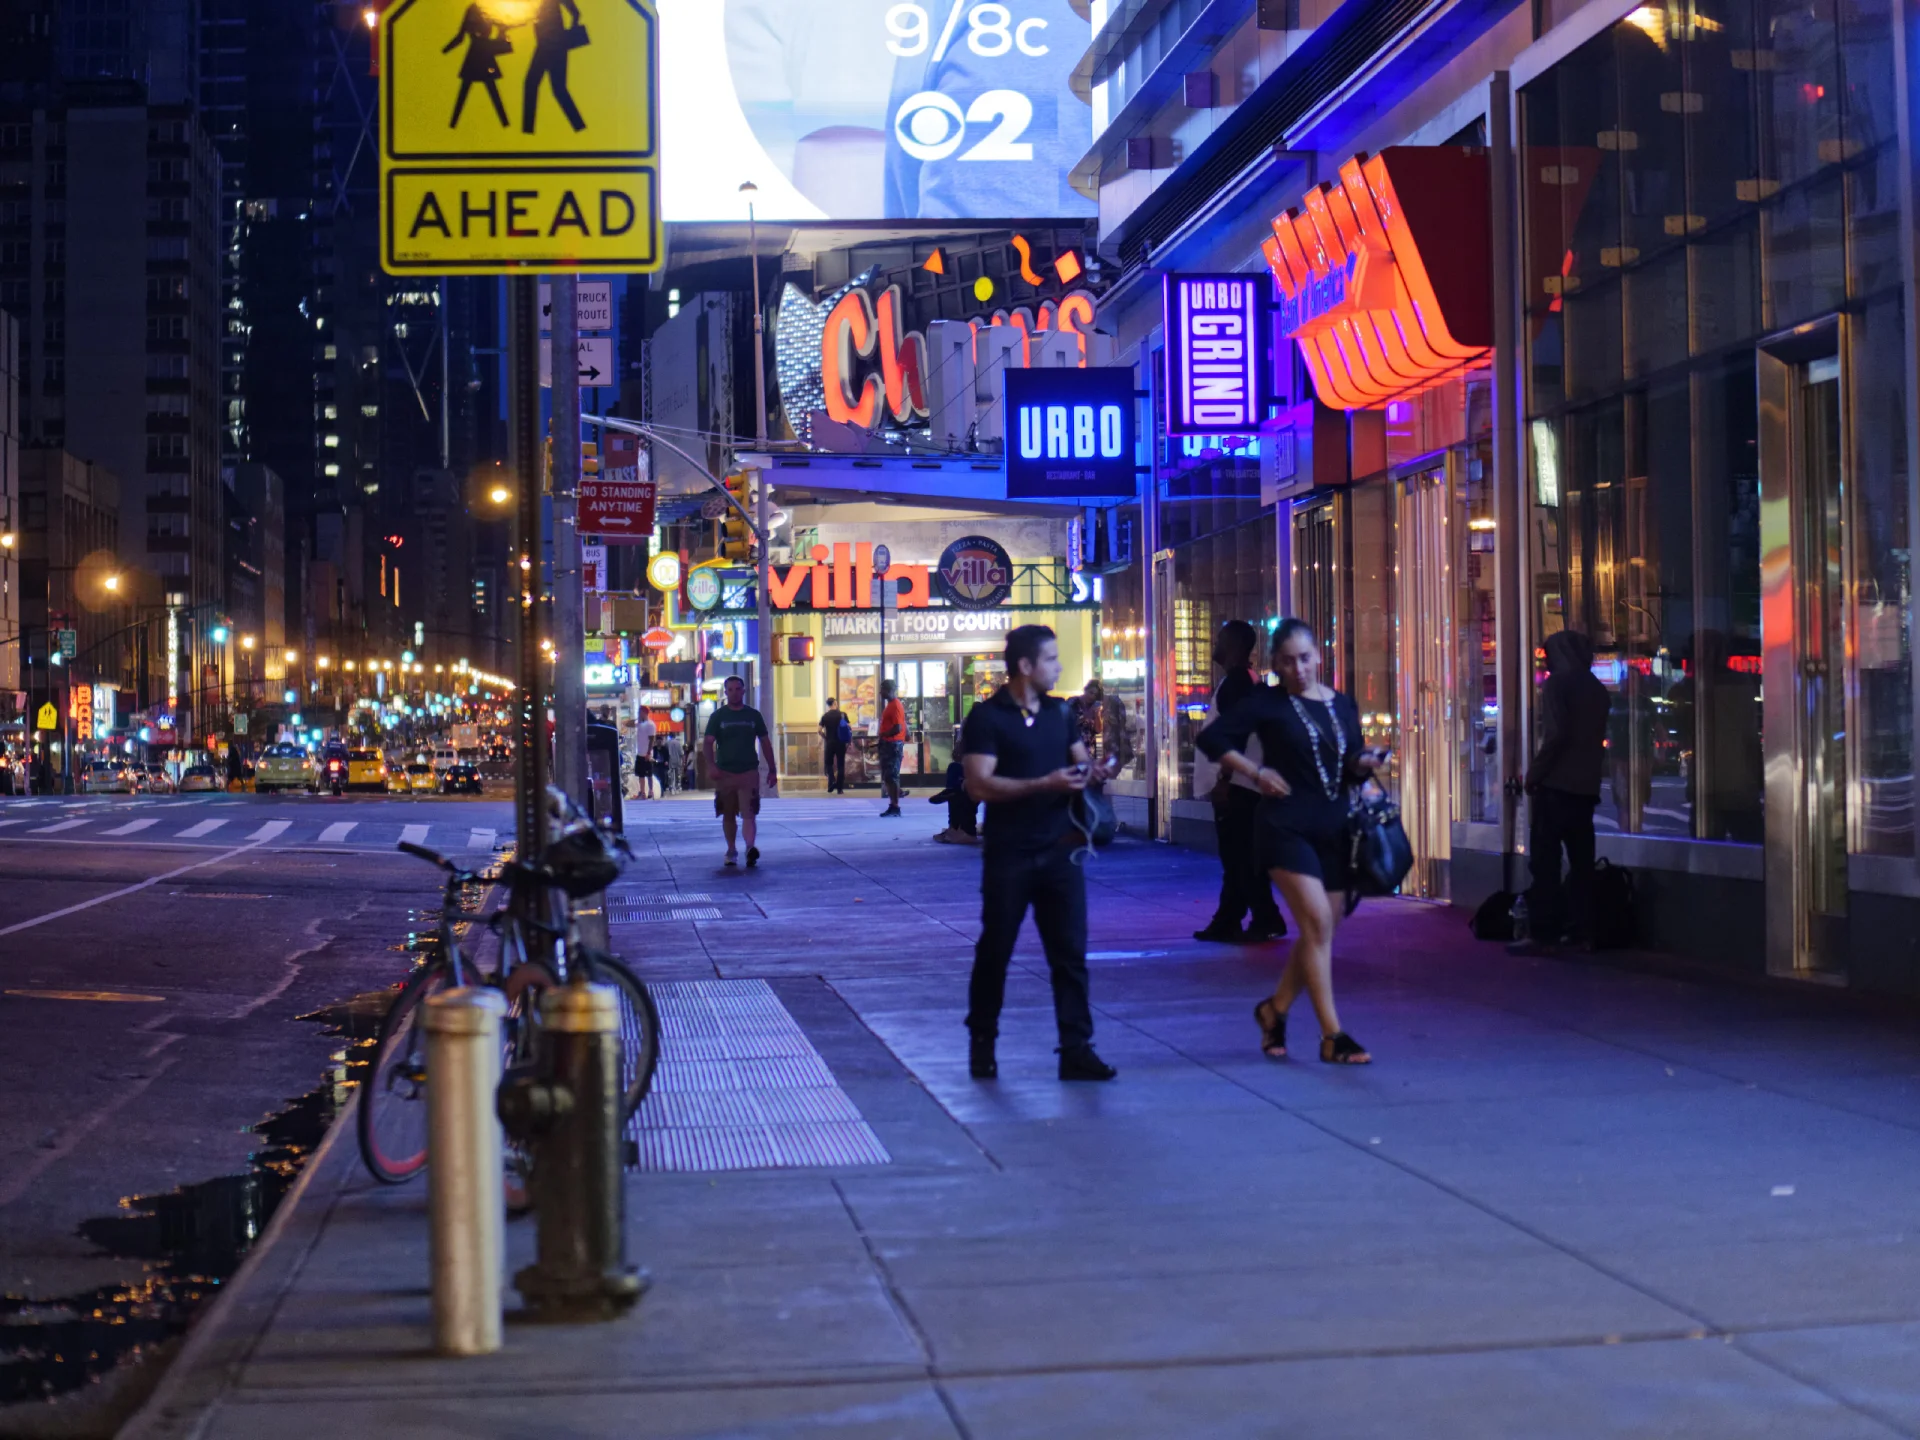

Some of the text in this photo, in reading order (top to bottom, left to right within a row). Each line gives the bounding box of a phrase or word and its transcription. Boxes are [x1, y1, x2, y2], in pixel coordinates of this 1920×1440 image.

[885, 1, 1050, 63] 9/8c
[408, 189, 636, 239] AHEAD
[577, 292, 608, 303] TRUCK
[1191, 281, 1242, 309] URBO
[577, 309, 608, 320] ROUTE
[1191, 313, 1245, 426] GRIND
[1019, 405, 1122, 459] URBO
[582, 486, 652, 499] NO STANDING
[589, 501, 643, 513] ANYTIME
[585, 549, 601, 558] BUS
[951, 540, 998, 553] PIZZA PASTA
[754, 541, 931, 610] villa
[940, 560, 1007, 586] villa
[688, 580, 718, 595] villa
[985, 588, 1006, 607] SALADS
[903, 615, 949, 632] FOOD
[953, 613, 1012, 632] COURT
[890, 633, 946, 642] AT TIMES SQUARE
[77, 685, 92, 739] BAR
